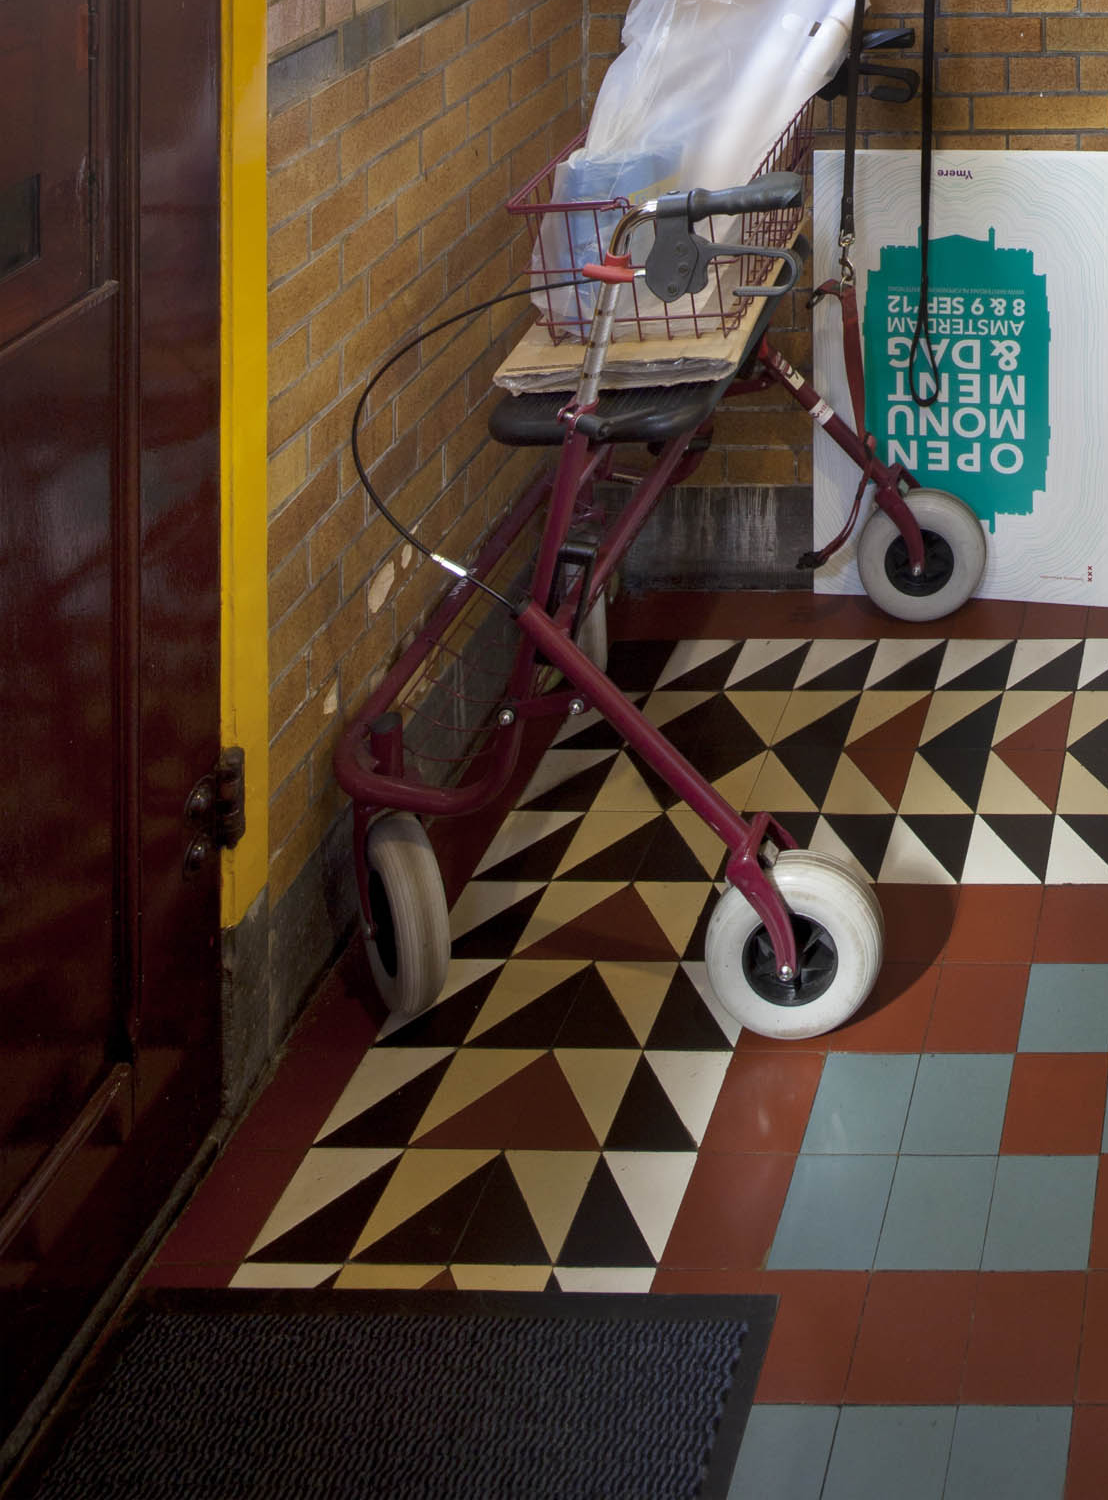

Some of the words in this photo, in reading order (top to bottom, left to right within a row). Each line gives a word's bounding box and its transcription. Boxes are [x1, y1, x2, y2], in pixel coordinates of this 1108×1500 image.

[936, 169, 973, 180] Ymere
[926, 296, 965, 315] SEP
[970, 297, 985, 315] 9
[989, 297, 1008, 317] &
[1012, 298, 1026, 317] 8
[887, 316, 1025, 336] AMSTERDAM
[887, 336, 981, 370] DAG
[990, 339, 1021, 372] &
[887, 371, 1026, 406] MENT
[887, 404, 1026, 440] MONU
[887, 439, 1024, 475] OPEN
